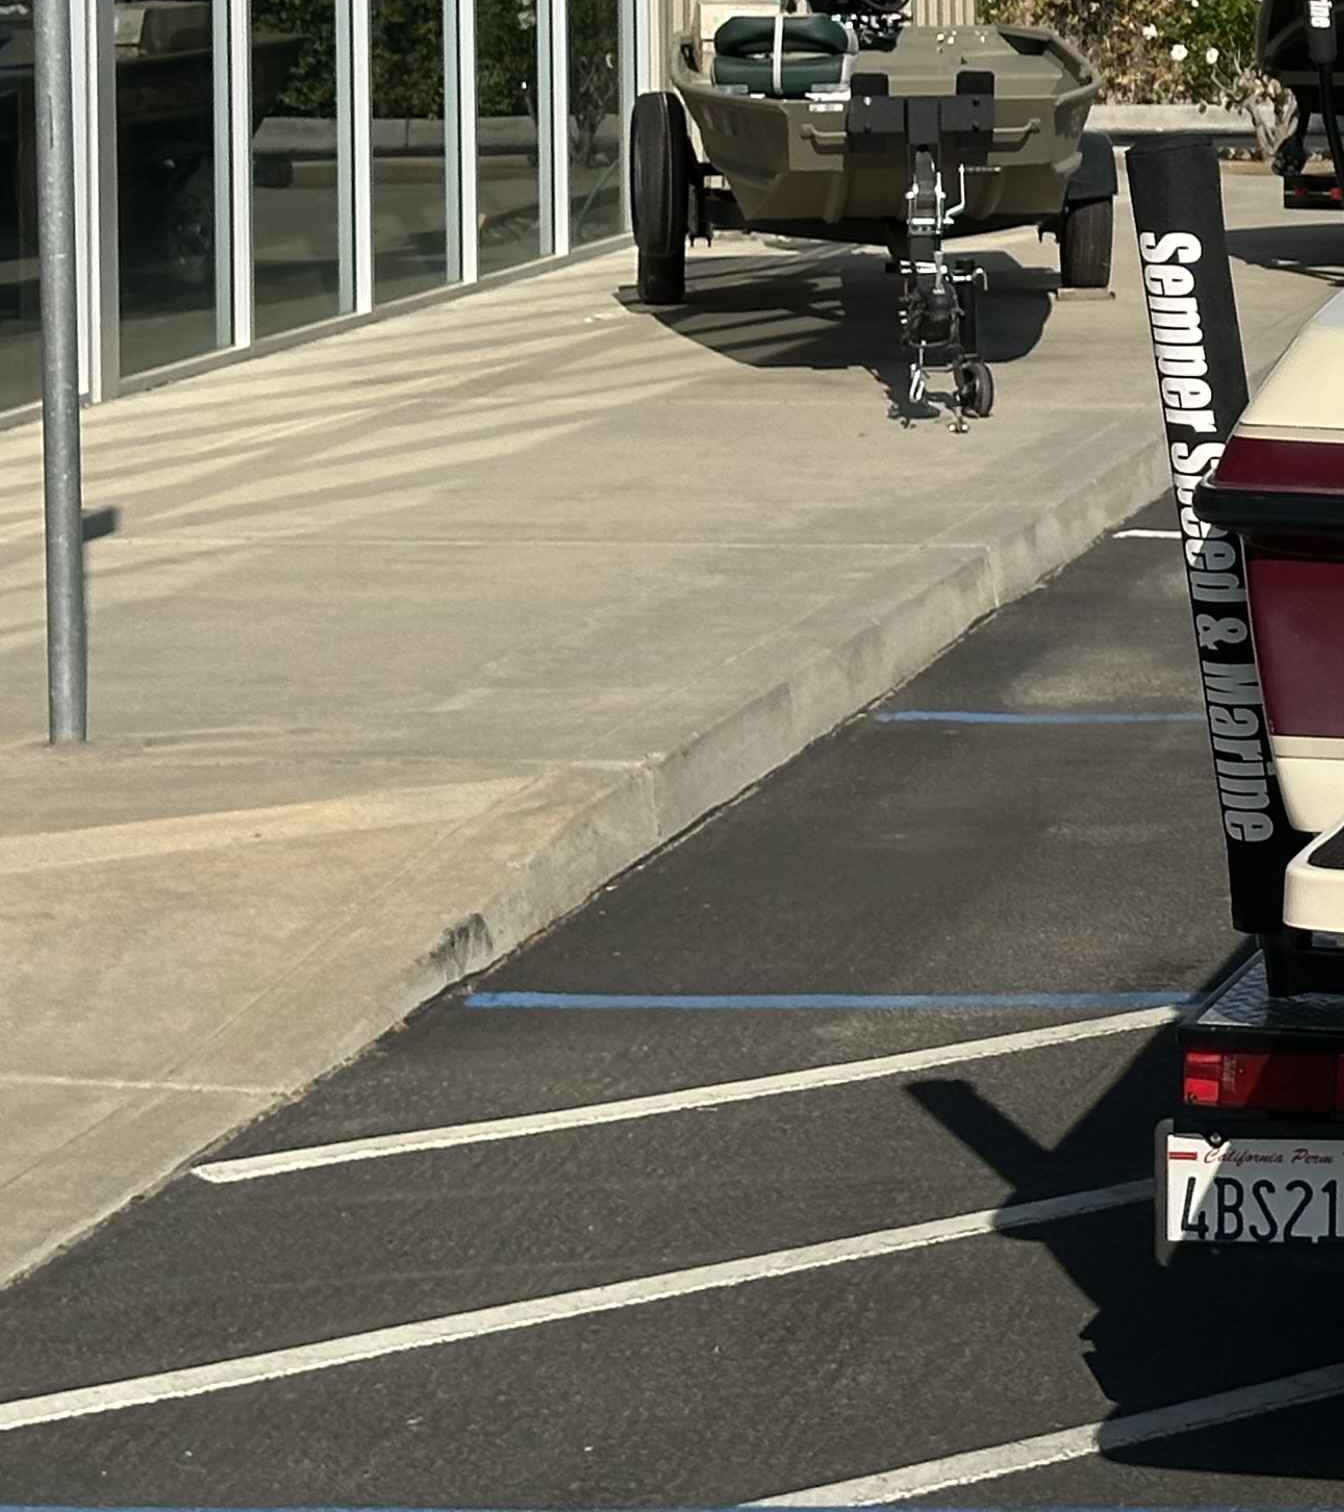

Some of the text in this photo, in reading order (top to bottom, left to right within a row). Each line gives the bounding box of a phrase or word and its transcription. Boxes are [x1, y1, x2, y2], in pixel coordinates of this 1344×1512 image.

[1140, 231, 1218, 433] Semper
[1196, 613, 1248, 651] &
[1202, 659, 1277, 843] Marine
[1203, 1147, 1284, 1167] California
[1291, 1147, 1333, 1165] Perm
